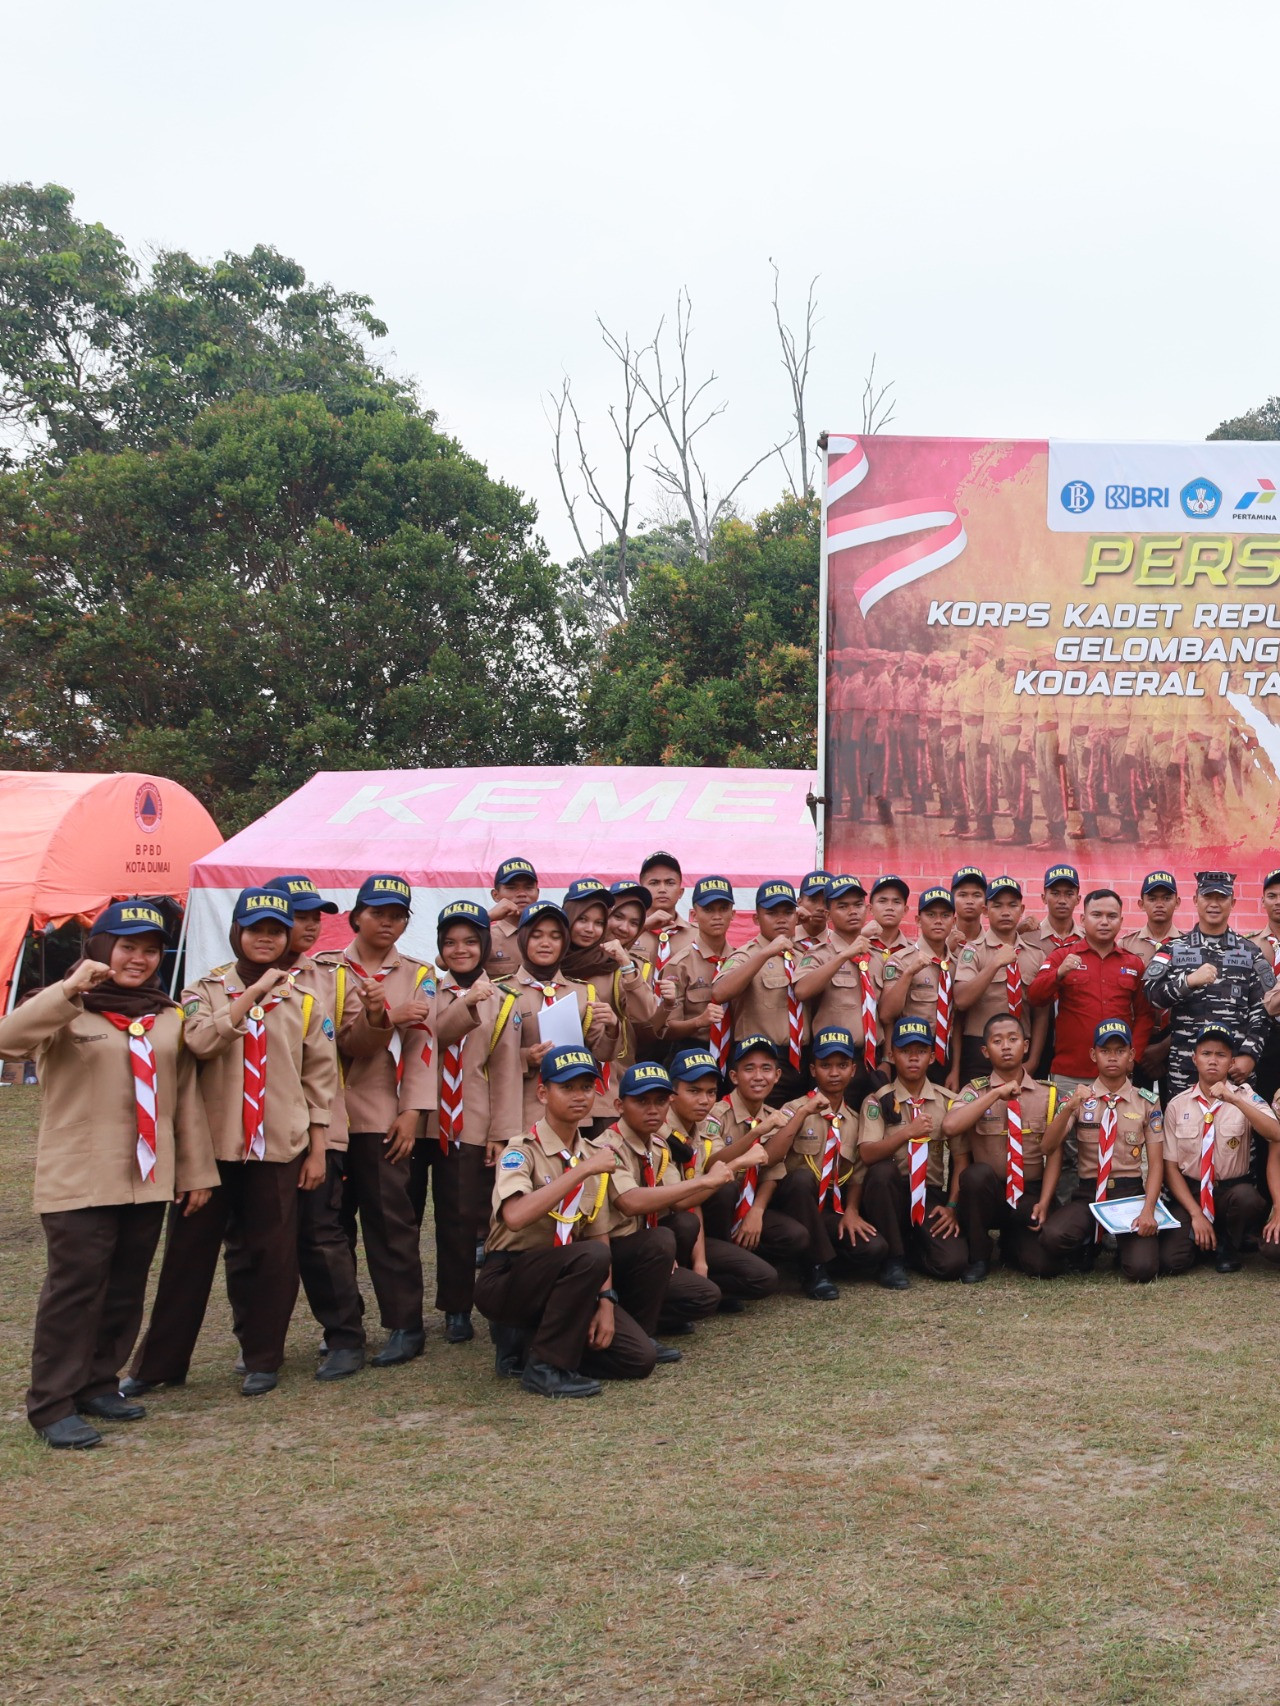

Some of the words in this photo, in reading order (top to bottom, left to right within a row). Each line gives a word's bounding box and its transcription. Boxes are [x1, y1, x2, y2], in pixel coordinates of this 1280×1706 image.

[1131, 487, 1169, 508] BRI
[1232, 513, 1277, 521] PERTAMINA
[927, 600, 1051, 628] KORPS
[1063, 603, 1182, 629] KADET
[1013, 670, 1206, 697] KODAERAL
[1218, 671, 1230, 697] I
[135, 844, 162, 856] BPBD
[125, 861, 146, 873] KOTA
[147, 861, 171, 873] DUMAI
[503, 861, 532, 873] KKRI
[1049, 868, 1074, 878] KKRI
[373, 879, 410, 898] KKRI
[699, 879, 729, 892] KKRI
[831, 877, 860, 889] KKRI
[991, 878, 1018, 889] KKRI
[765, 884, 793, 897] KKRI
[765, 884, 793, 897] KKRI
[924, 890, 952, 900] KKRI
[246, 895, 289, 913] KKRI
[1240, 959, 1250, 967] AL
[899, 1023, 927, 1036] KKRI
[1098, 1023, 1126, 1035] KKRI
[820, 1032, 849, 1045] KKRI
[554, 1053, 594, 1070] KKRI
[684, 1054, 717, 1068] KKRI
[634, 1066, 670, 1081] KKRI
